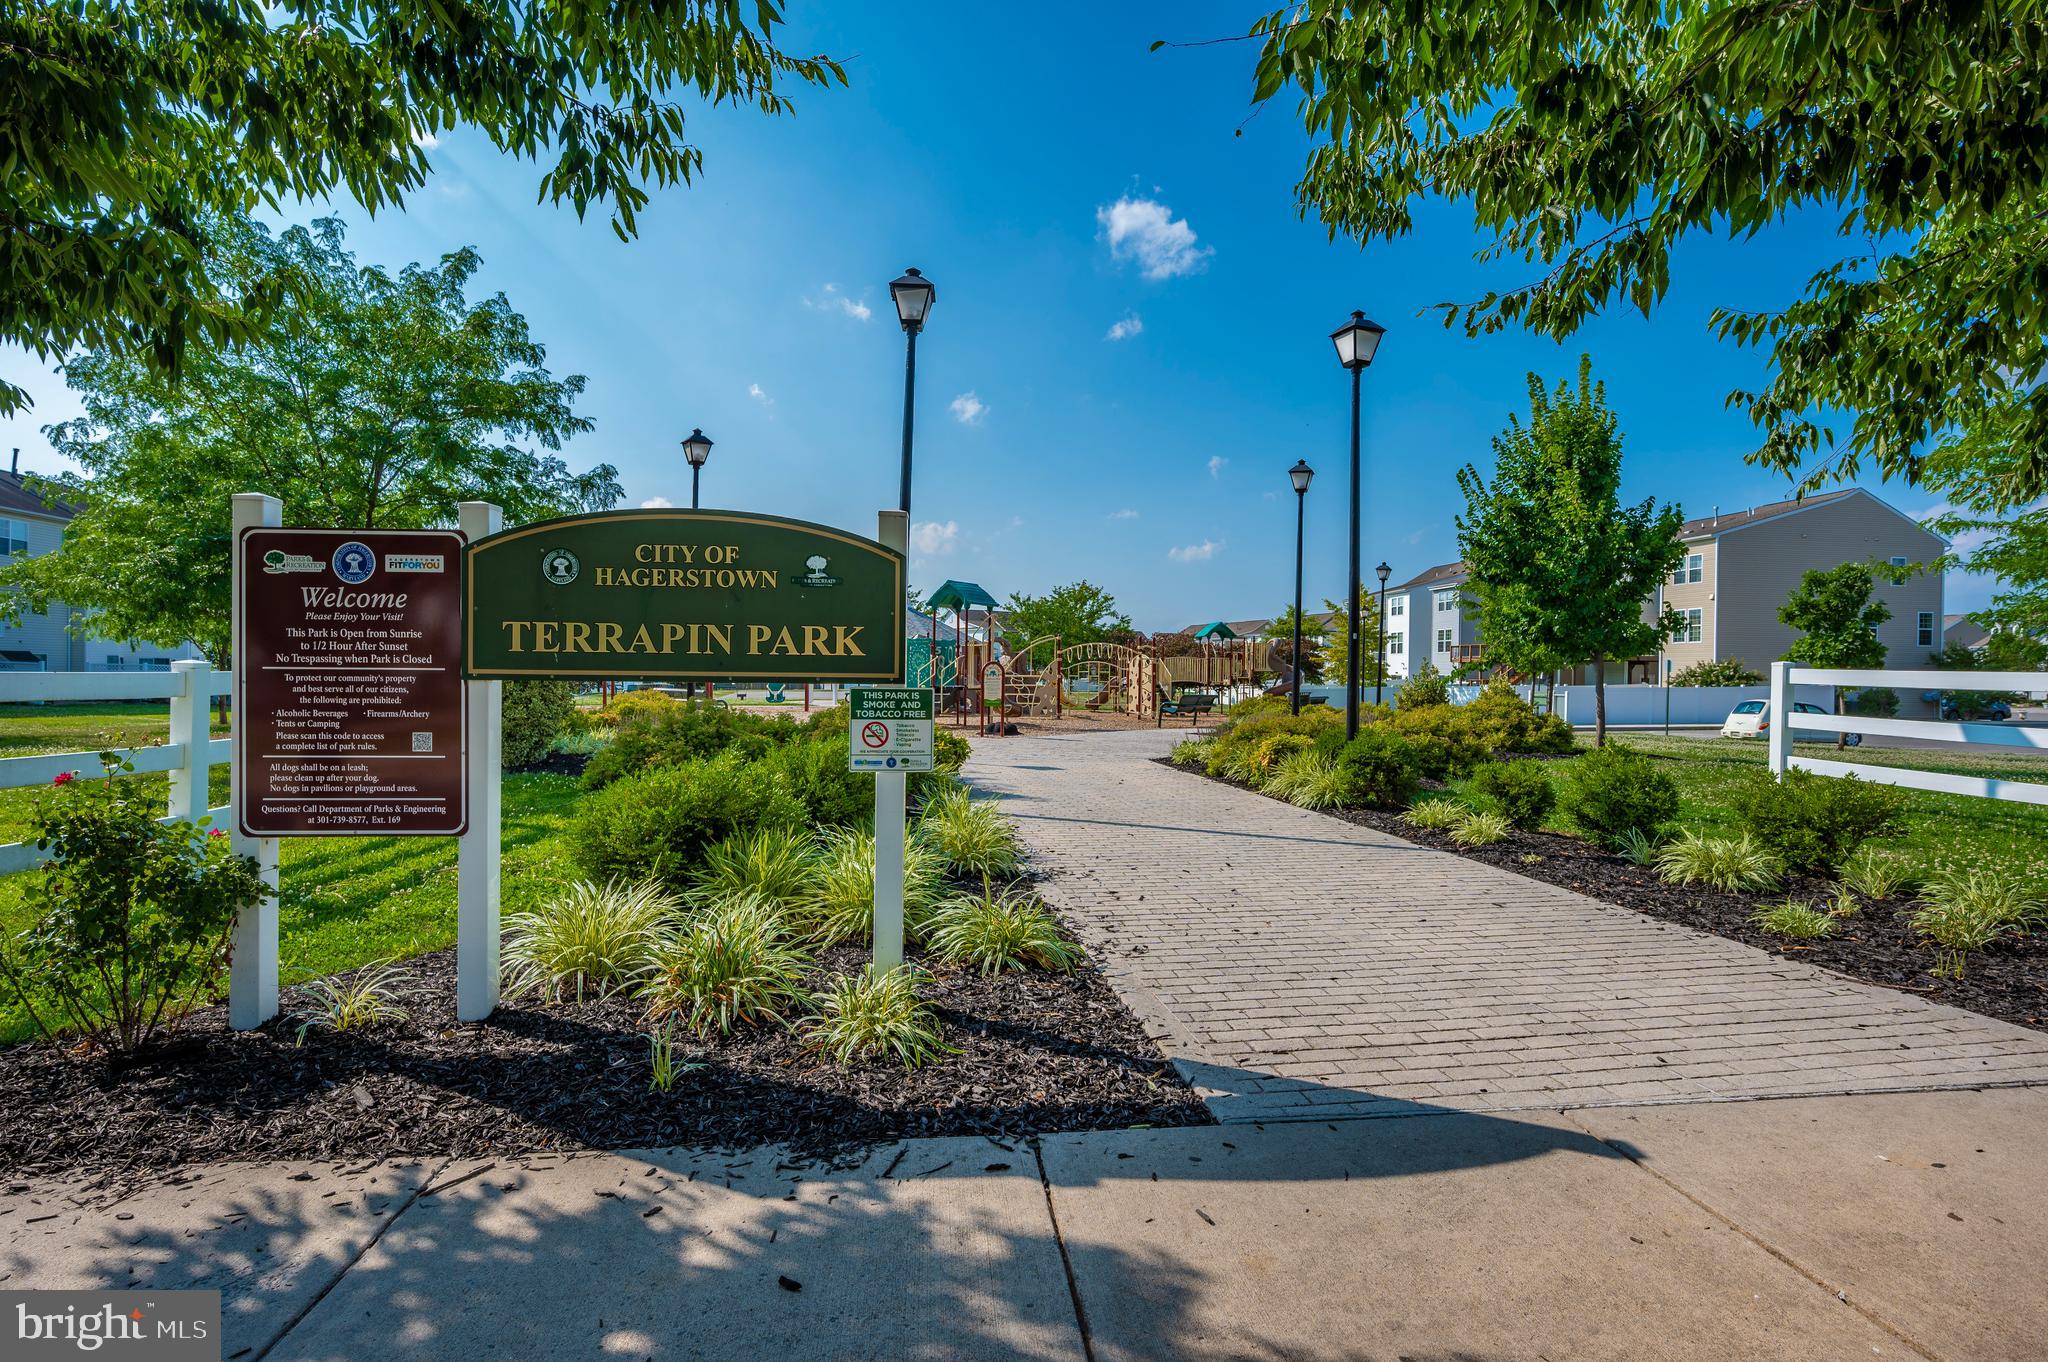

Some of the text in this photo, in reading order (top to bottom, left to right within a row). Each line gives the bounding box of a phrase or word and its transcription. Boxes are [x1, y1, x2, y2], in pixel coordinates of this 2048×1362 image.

[635, 544, 739, 564] CITY OF
[594, 568, 778, 589] HAGERSTOWN
[301, 587, 407, 608] Welcome
[305, 612, 332, 620] Please
[334, 612, 358, 622] Enjoy
[286, 628, 422, 640] This Park is Open from Sunrise
[502, 621, 866, 656] TERRAPIN PARK
[313, 641, 326, 650] 1/2
[329, 641, 353, 650] Hour
[355, 641, 377, 650] After
[379, 642, 408, 651] Sunset
[276, 654, 432, 665] No Trespassing when Park is Closed
[296, 675, 322, 683] protect
[338, 675, 383, 683] community's
[385, 675, 416, 684] property
[313, 696, 347, 705] following
[362, 696, 401, 705] prohibited:
[312, 710, 348, 719] Beverages
[307, 720, 340, 729] Camping
[282, 742, 315, 752] complete
[339, 742, 355, 752] park
[282, 764, 299, 772] dogs
[270, 774, 292, 783] please
[364, 774, 379, 783] dog.
[283, 784, 300, 793] dogs
[310, 784, 343, 794] pavilions
[355, 784, 395, 794] playground
[261, 805, 300, 814] Questions?
[319, 805, 362, 814] Department
[403, 805, 446, 814] Engineering
